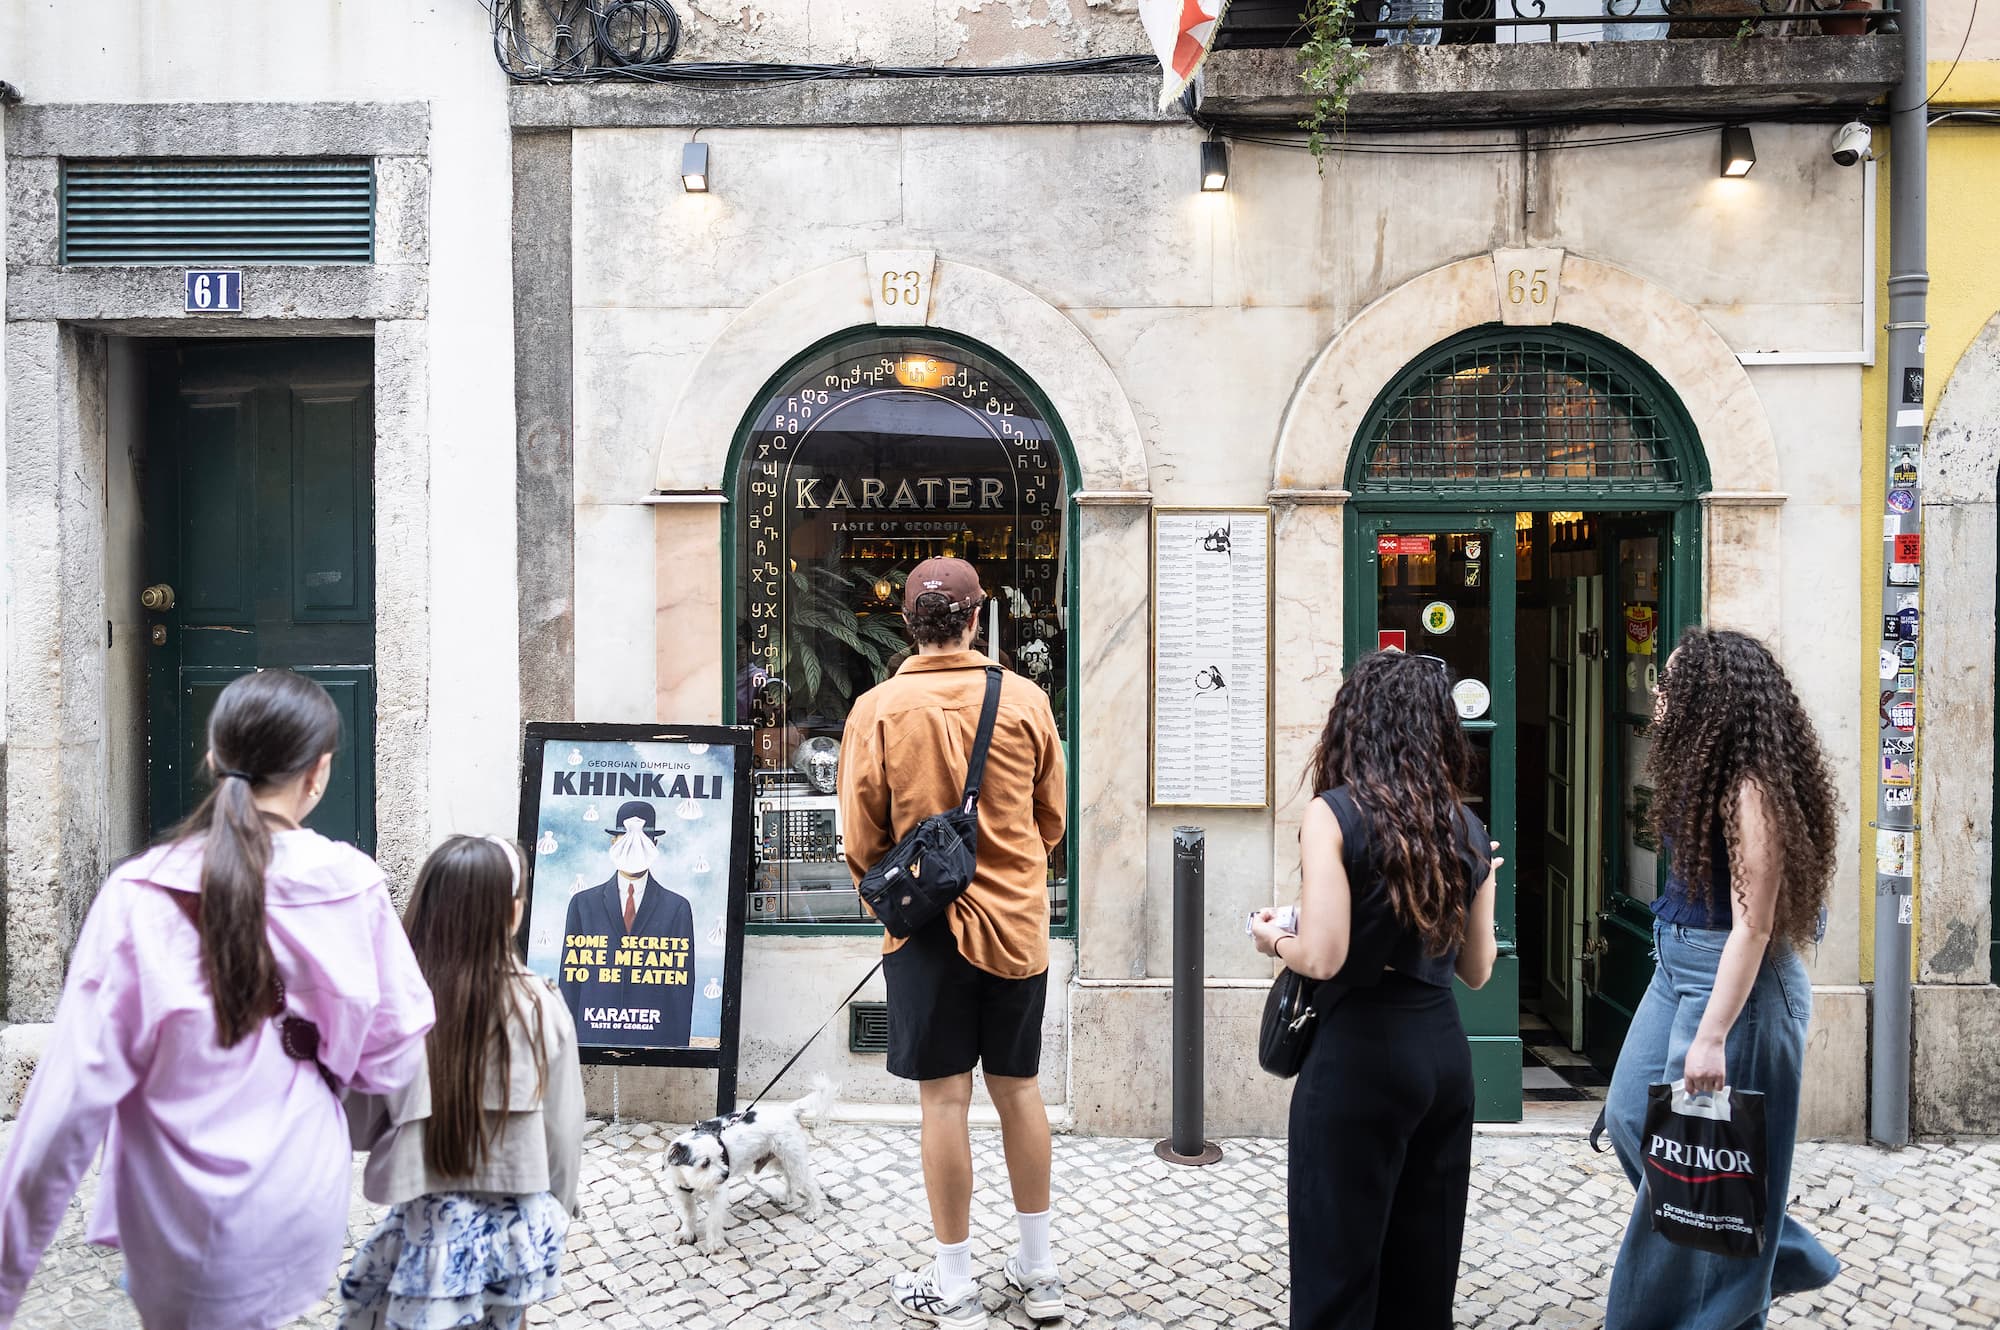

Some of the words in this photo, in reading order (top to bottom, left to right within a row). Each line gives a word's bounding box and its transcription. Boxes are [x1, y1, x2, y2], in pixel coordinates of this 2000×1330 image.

[194, 274, 229, 308] 61
[882, 271, 920, 306] 63
[1508, 269, 1548, 304] 65
[795, 478, 1005, 510] KARATER
[831, 522, 874, 531] TASTE
[880, 522, 895, 531] OF
[904, 522, 968, 531] GEORGIA
[588, 760, 637, 769] GEORGIAN
[640, 761, 691, 770] DUMPLING
[552, 771, 723, 800] KHINKALI
[566, 935, 608, 948] SOME
[621, 936, 689, 951] SECRETS
[564, 949, 607, 965] ARE
[614, 951, 688, 968] MEANT
[564, 967, 590, 982] TO
[598, 968, 621, 983] BE
[631, 969, 688, 985] EATEN
[584, 1007, 661, 1023] KARATER
[1649, 1134, 1754, 1174] PRIMOR
[1662, 1203, 1705, 1220] Grandes
[1706, 1215, 1744, 1225] marcas
[1715, 1223, 1753, 1235] precios
